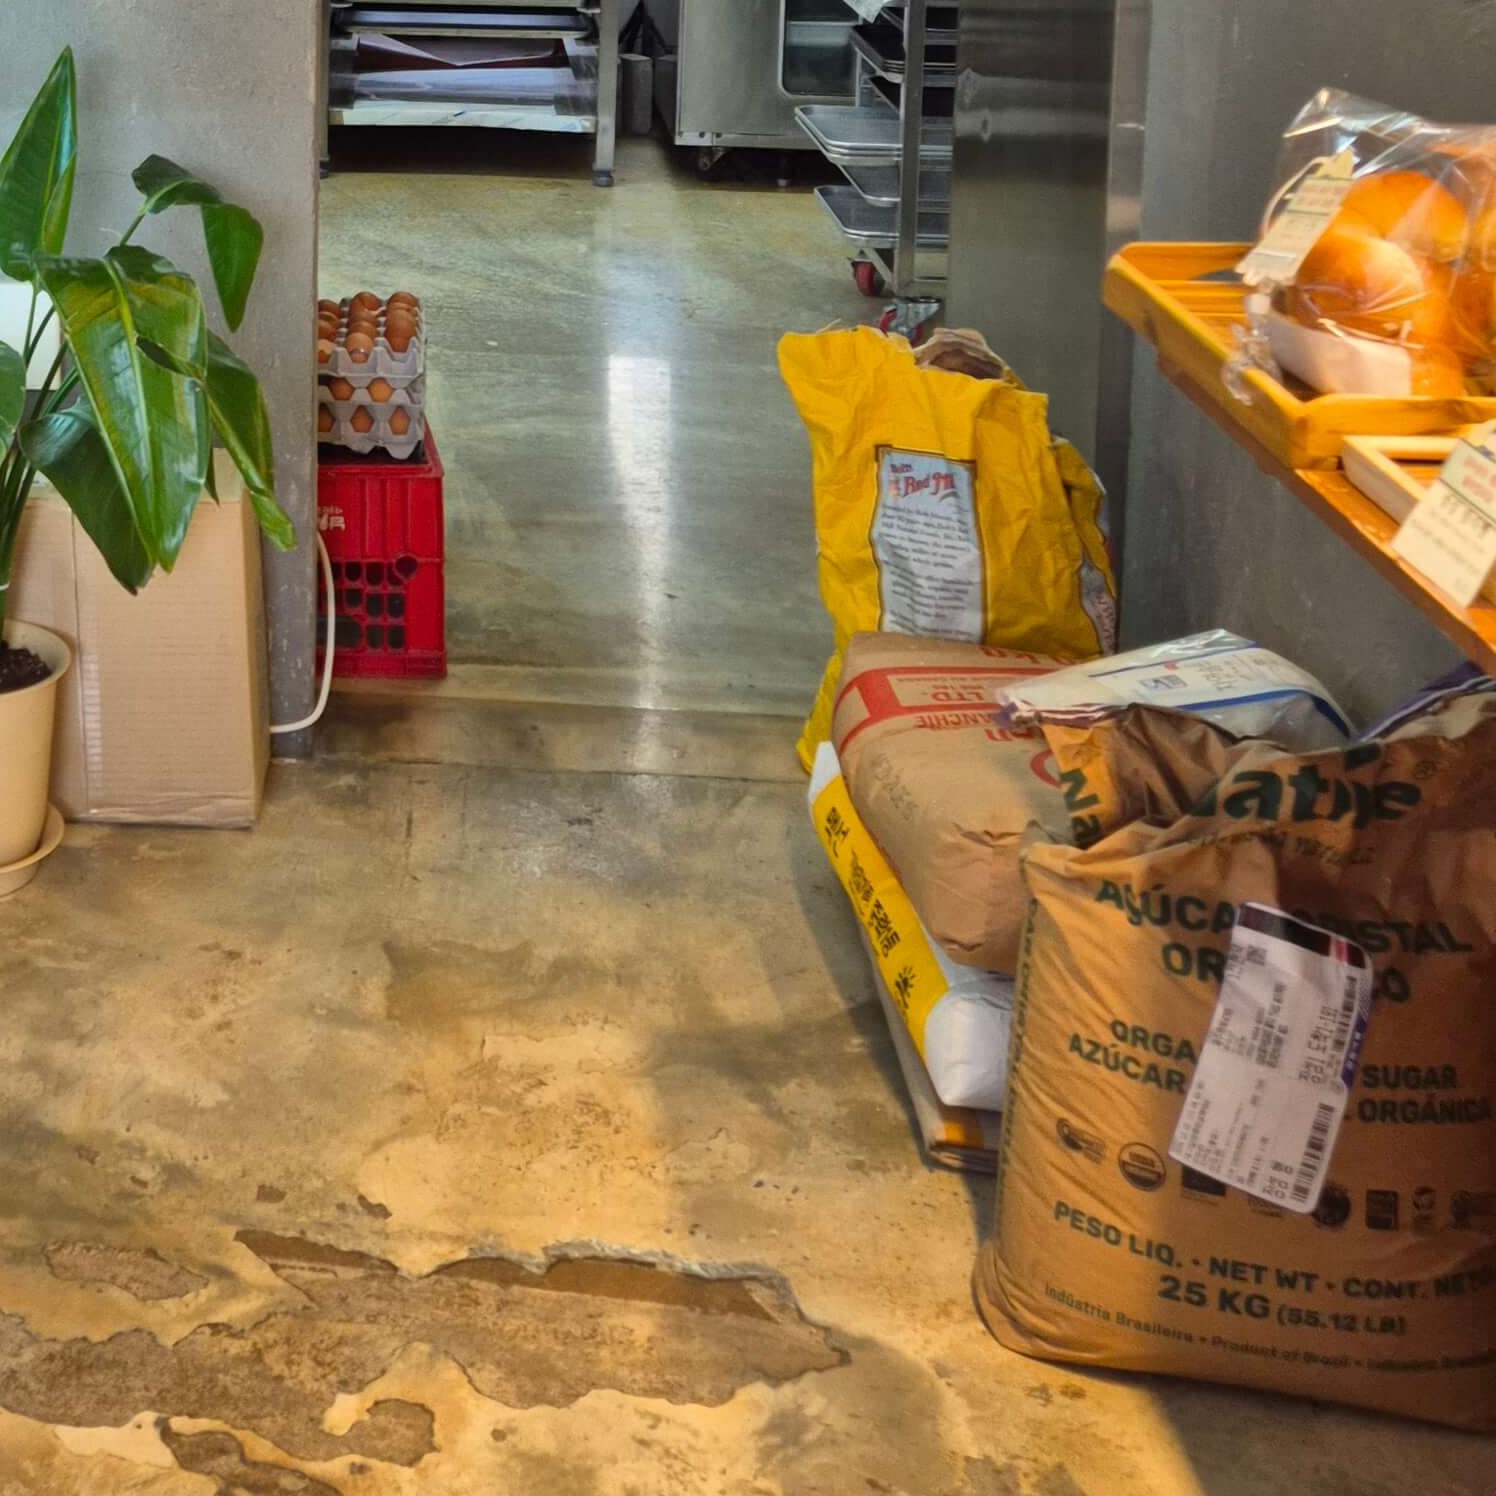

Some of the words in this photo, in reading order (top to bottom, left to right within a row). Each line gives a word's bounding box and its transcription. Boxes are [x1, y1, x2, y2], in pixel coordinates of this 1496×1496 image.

[915, 712, 994, 730] ANCHIE
[1094, 878, 1237, 932] AÇÚCA
[1068, 1032, 1186, 1095] AZÚCAR
[1361, 1064, 1457, 1090] SUGAR
[1053, 1200, 1121, 1246] PESO
[1128, 1234, 1184, 1269] LIQ.
[1208, 1256, 1268, 1286] NET
[1275, 1267, 1319, 1293] WT
[1158, 1273, 1209, 1308] 25
[1217, 1287, 1271, 1320] KG
